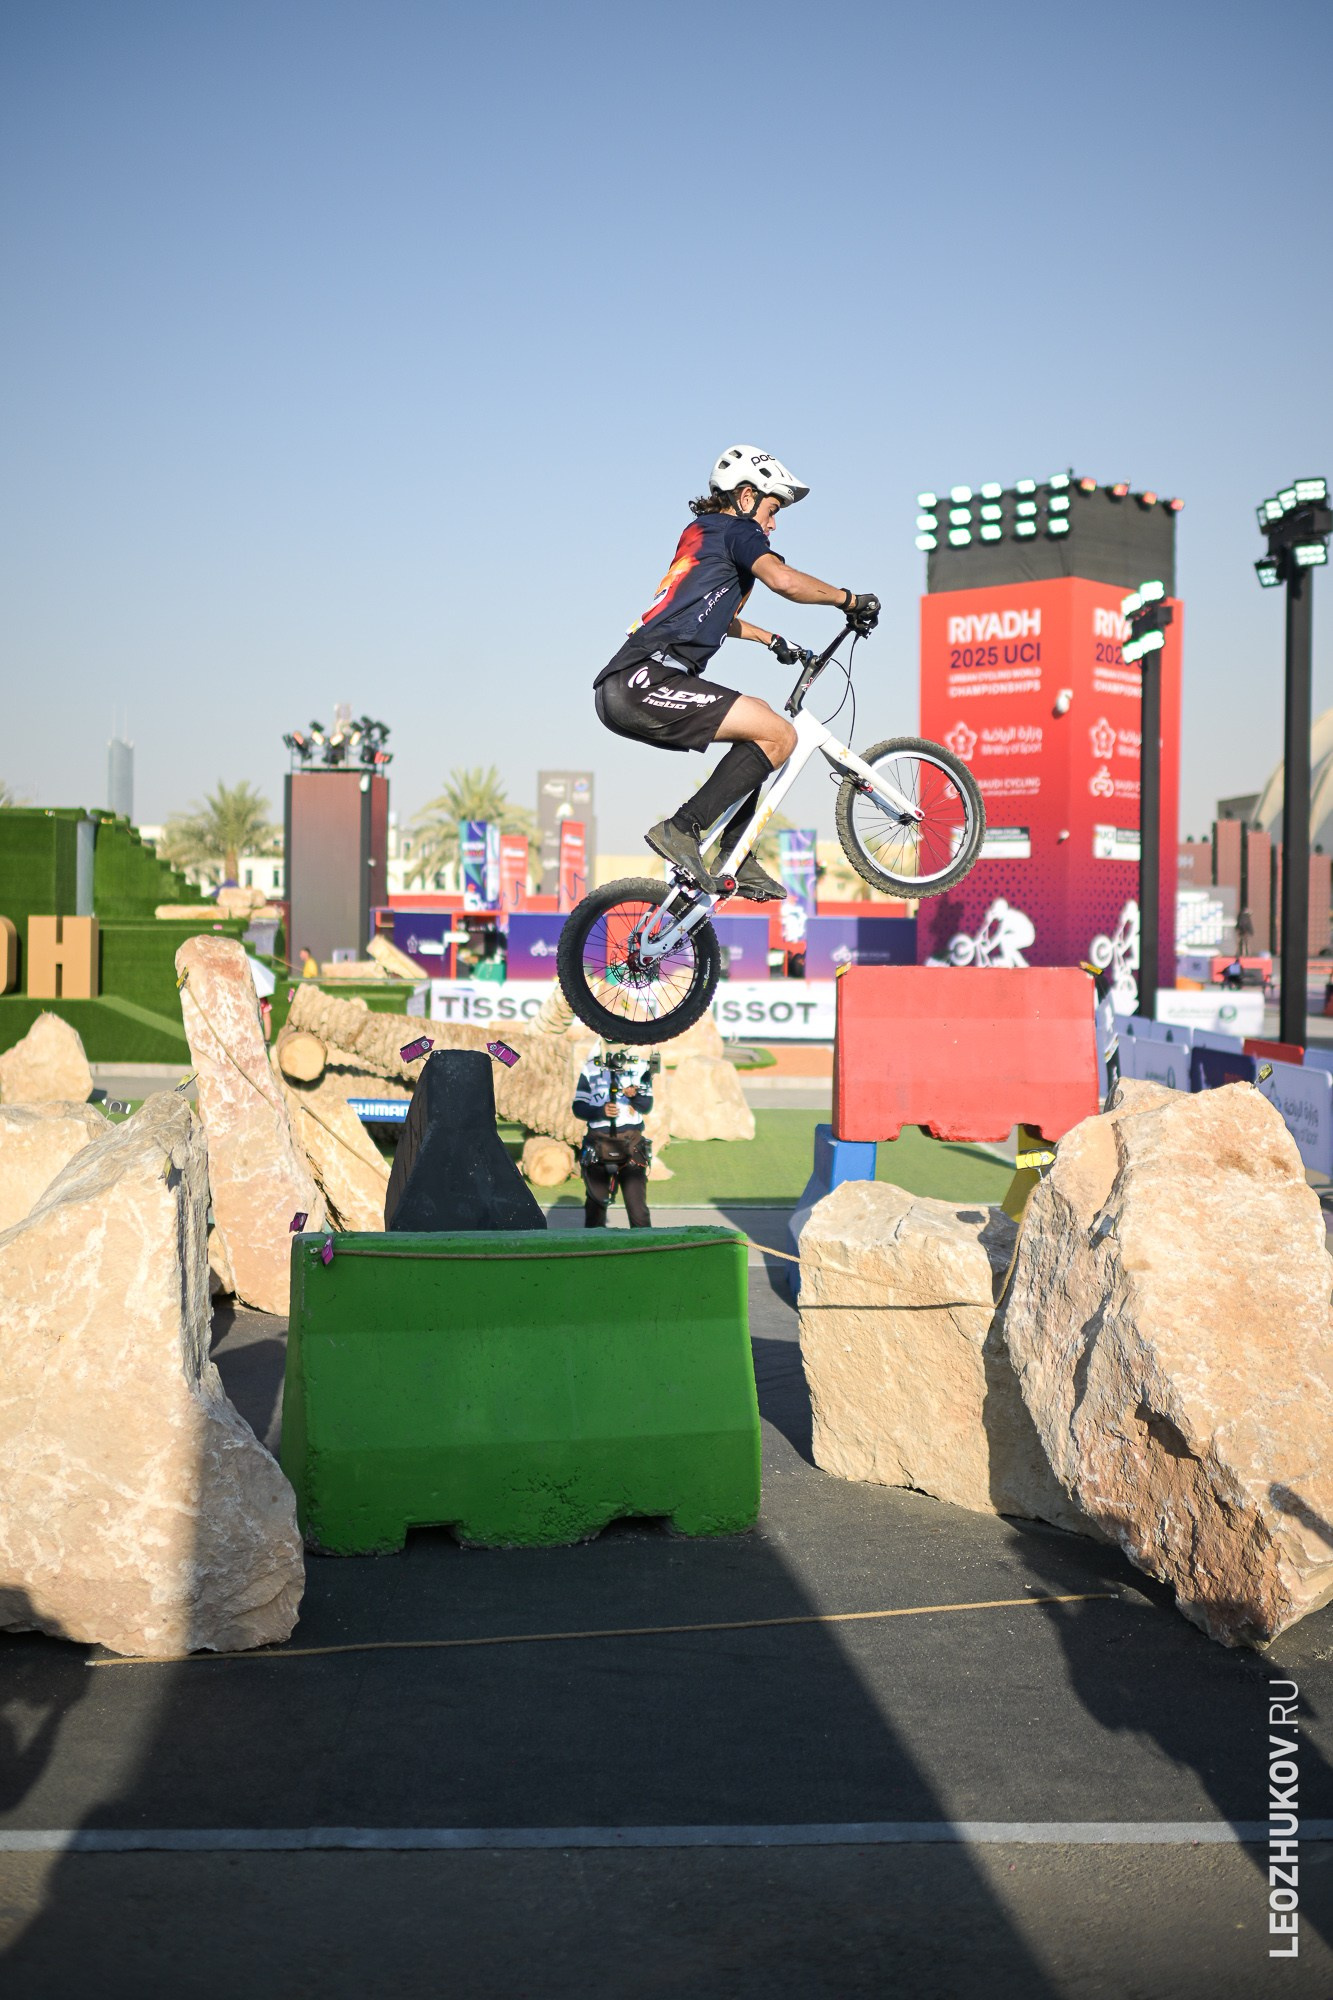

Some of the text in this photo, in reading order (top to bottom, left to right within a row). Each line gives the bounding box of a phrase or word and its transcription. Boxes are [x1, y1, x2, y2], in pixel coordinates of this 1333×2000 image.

[949, 608, 1041, 644] RIYADH
[950, 643, 1041, 668] 2025 UCI
[1095, 642, 1124, 666] 202
[1012, 667, 1041, 678] WORLD
[949, 680, 1041, 698] CHAMPIONSHIPS
[438, 996, 544, 1020] TISSO
[712, 1000, 818, 1024] ISSOT
